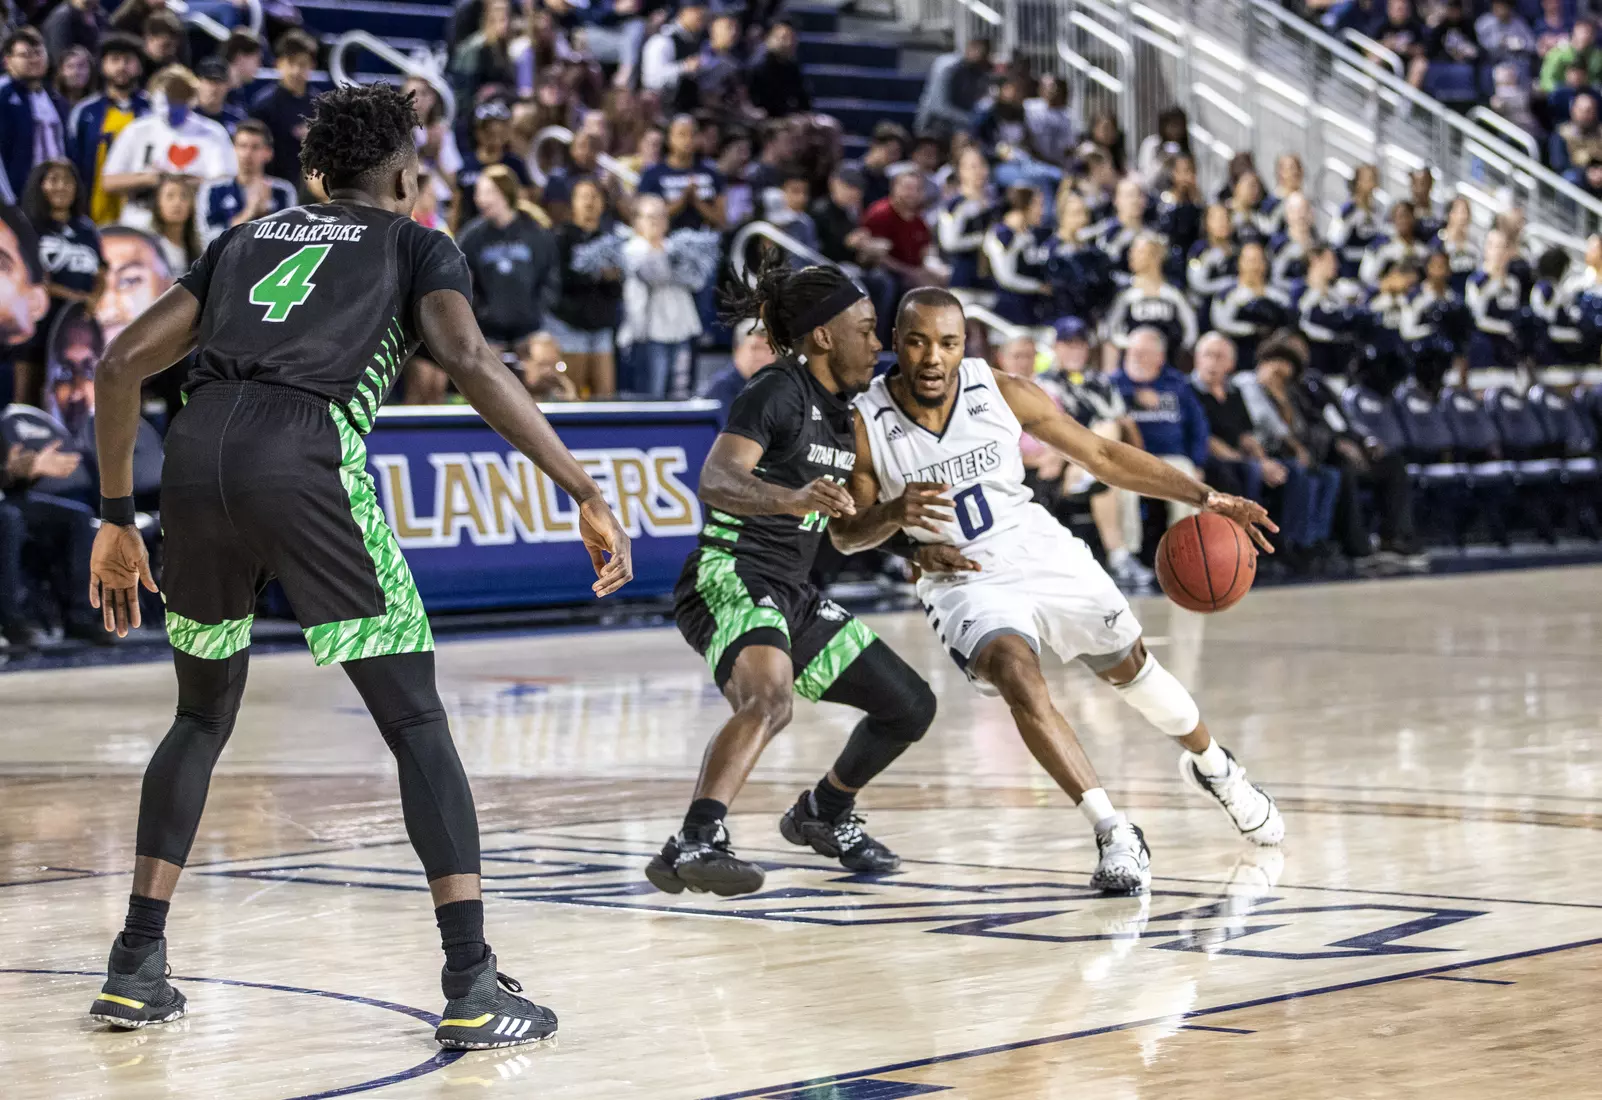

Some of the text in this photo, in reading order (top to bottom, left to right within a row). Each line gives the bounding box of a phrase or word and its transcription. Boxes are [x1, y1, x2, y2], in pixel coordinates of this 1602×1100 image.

[253, 221, 368, 242] OLOJAKPOKE
[248, 243, 334, 322] 4
[967, 402, 989, 417] WAC
[806, 443, 834, 467] UTAH
[953, 483, 994, 541] 0
